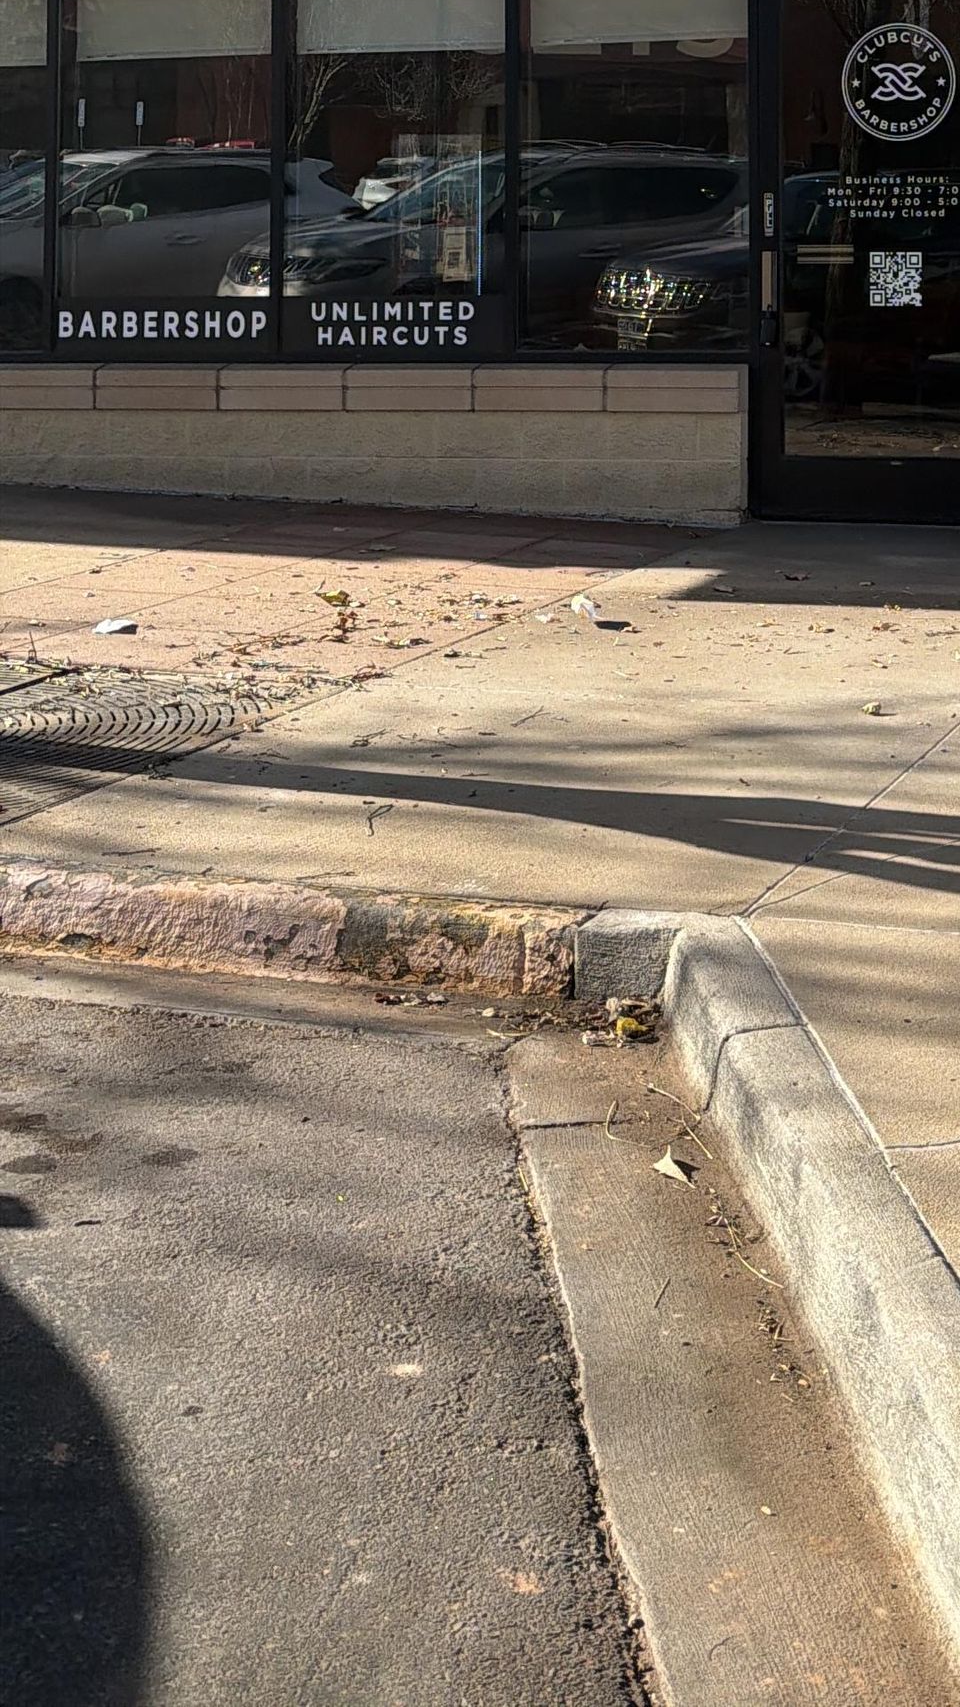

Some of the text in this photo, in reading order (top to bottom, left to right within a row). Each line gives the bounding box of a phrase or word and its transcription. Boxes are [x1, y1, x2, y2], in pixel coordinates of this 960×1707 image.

[856, 32, 941, 63] CLUBCUTS
[855, 97, 942, 132] BARBERSHOP
[845, 175, 949, 184] Business Hours:
[827, 187, 852, 195] Mon
[869, 187, 887, 195] Fri
[893, 186, 921, 195] 9:30
[828, 198, 884, 207] Saturday
[891, 197, 920, 206] 9:00
[850, 209, 945, 218] Sunday Closed
[310, 301, 475, 321] UNLIMITED
[58, 310, 267, 338] BARBERSHOP
[317, 326, 469, 345] HAIRCUTS
